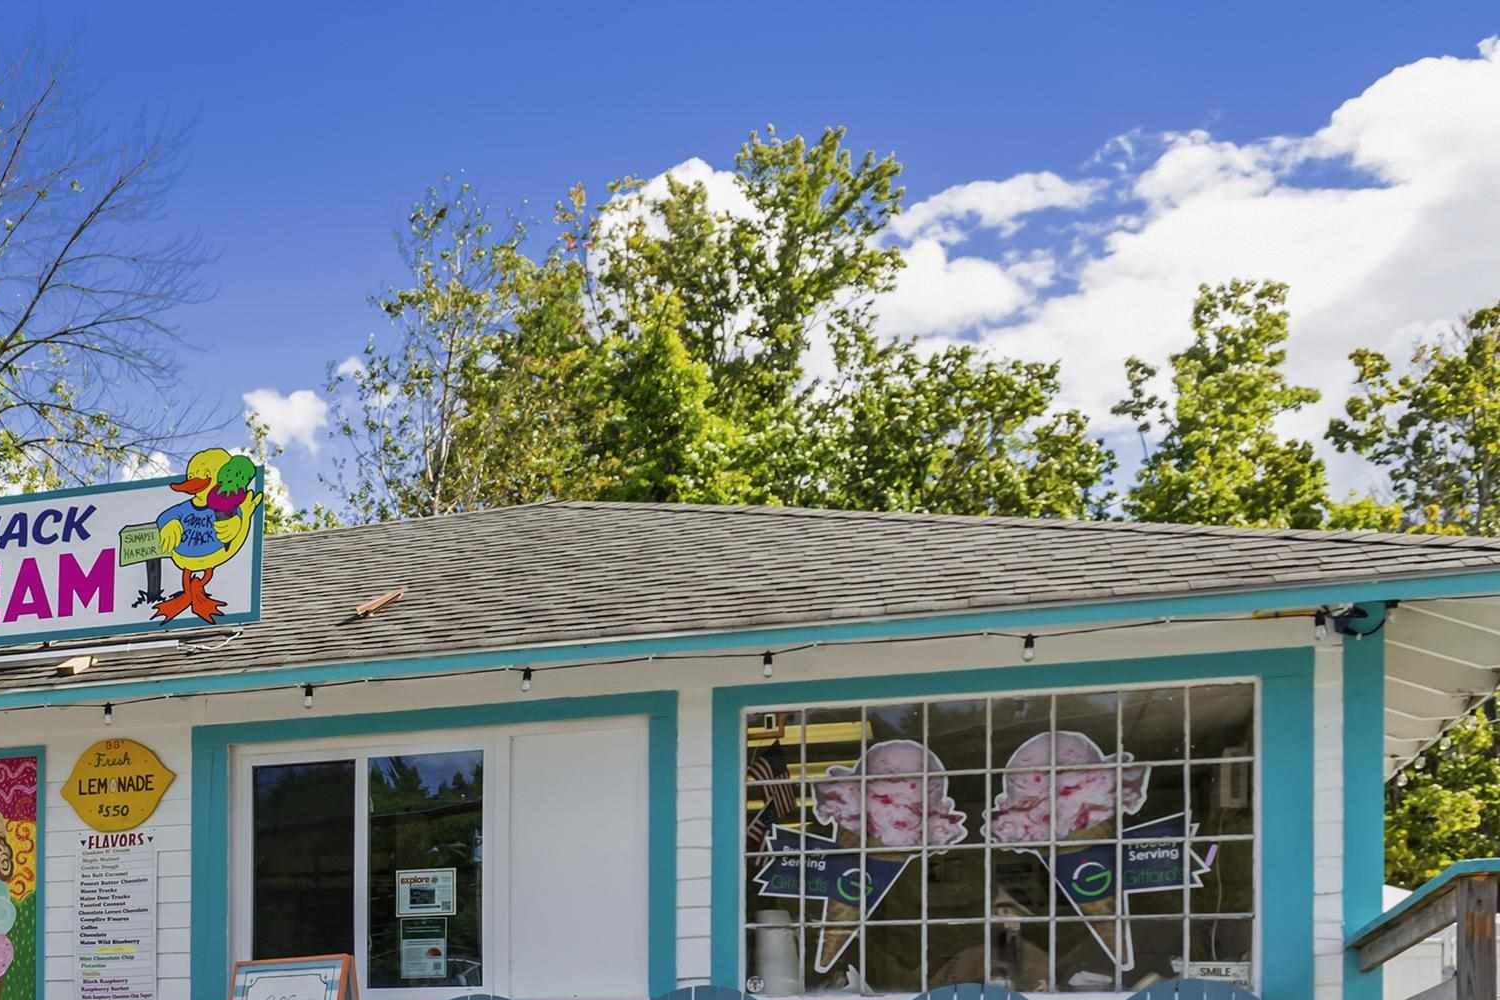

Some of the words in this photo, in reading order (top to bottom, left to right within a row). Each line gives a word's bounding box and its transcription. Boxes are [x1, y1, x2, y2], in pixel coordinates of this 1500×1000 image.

[183, 513, 213, 528] QUACK
[181, 530, 215, 547] SHACK
[124, 547, 157, 561] HARBOR
[93, 752, 132, 768] Fresh
[88, 832, 144, 849] FLAVORS
[1128, 847, 1180, 862] Serving
[781, 856, 826, 871] Sering
[1200, 967, 1231, 977] SMILE
